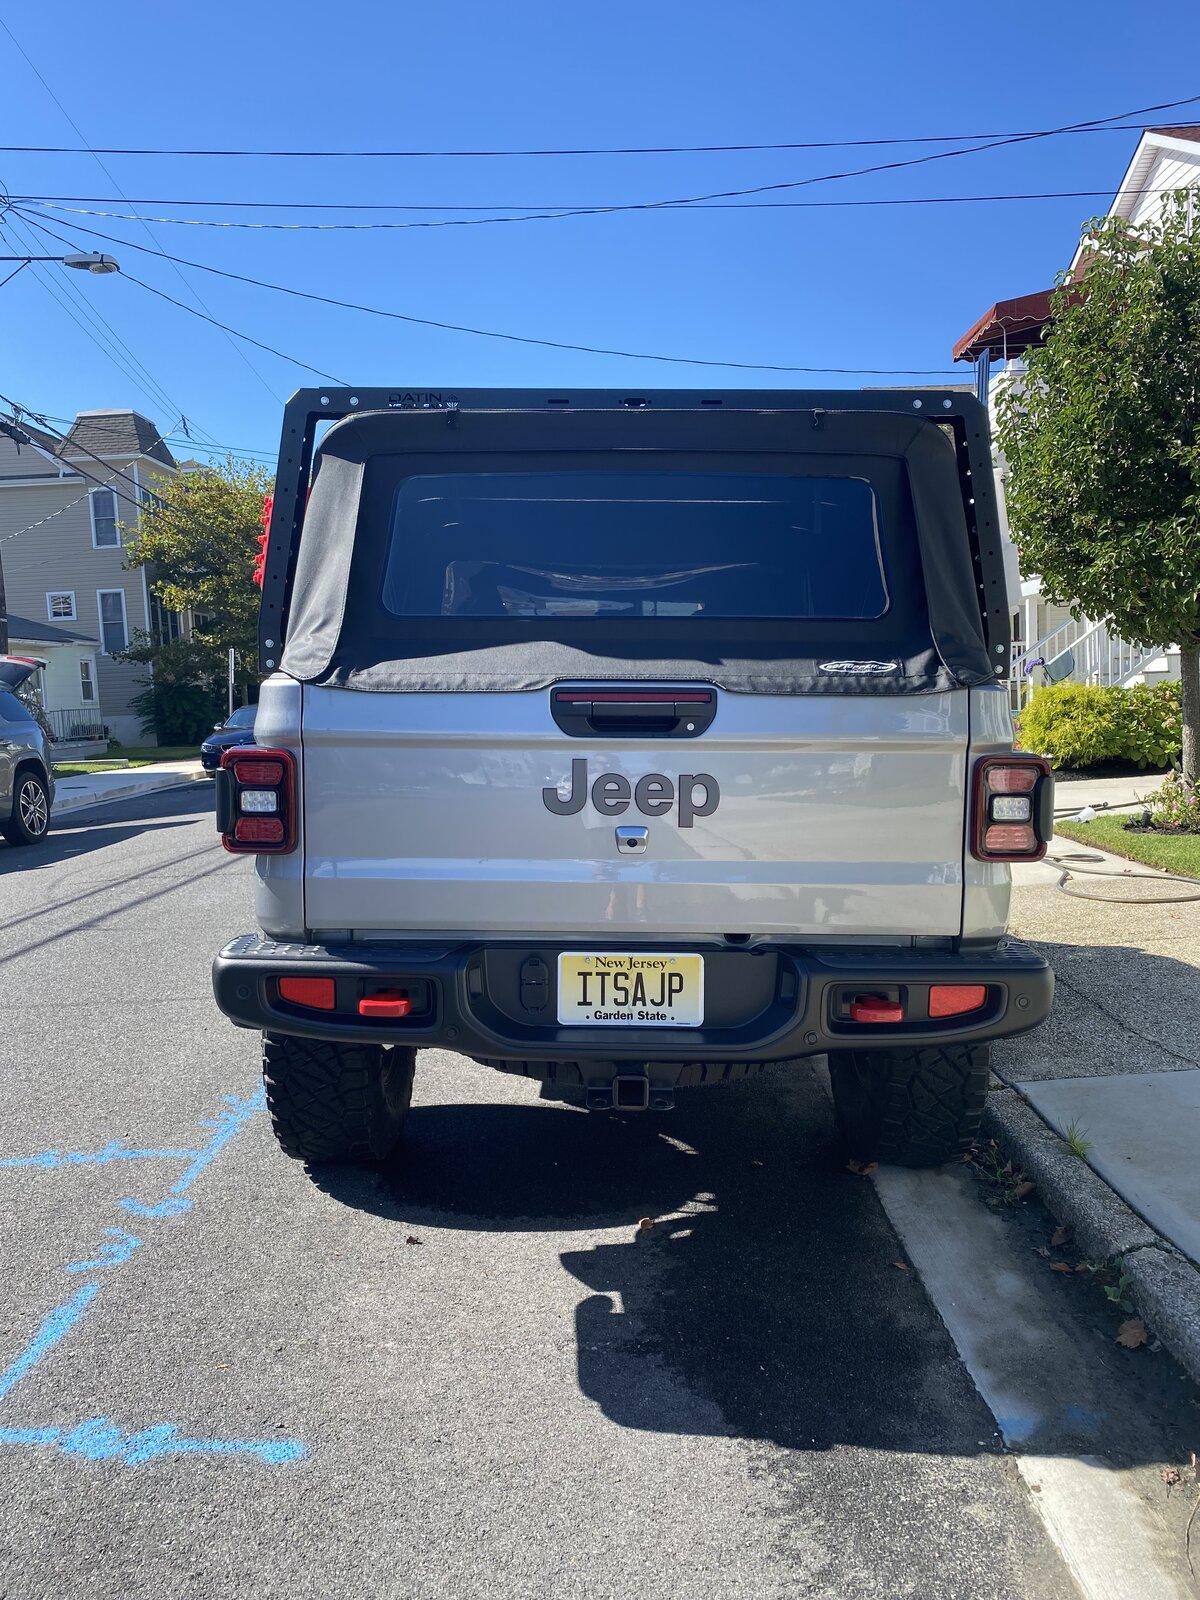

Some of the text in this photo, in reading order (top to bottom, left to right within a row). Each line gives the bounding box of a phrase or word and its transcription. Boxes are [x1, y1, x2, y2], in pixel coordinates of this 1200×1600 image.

[542, 758, 721, 828] Jeep
[595, 956, 668, 971] New Jersey
[577, 972, 684, 1007] ITSAJP
[594, 1010, 667, 1021] Garden State
